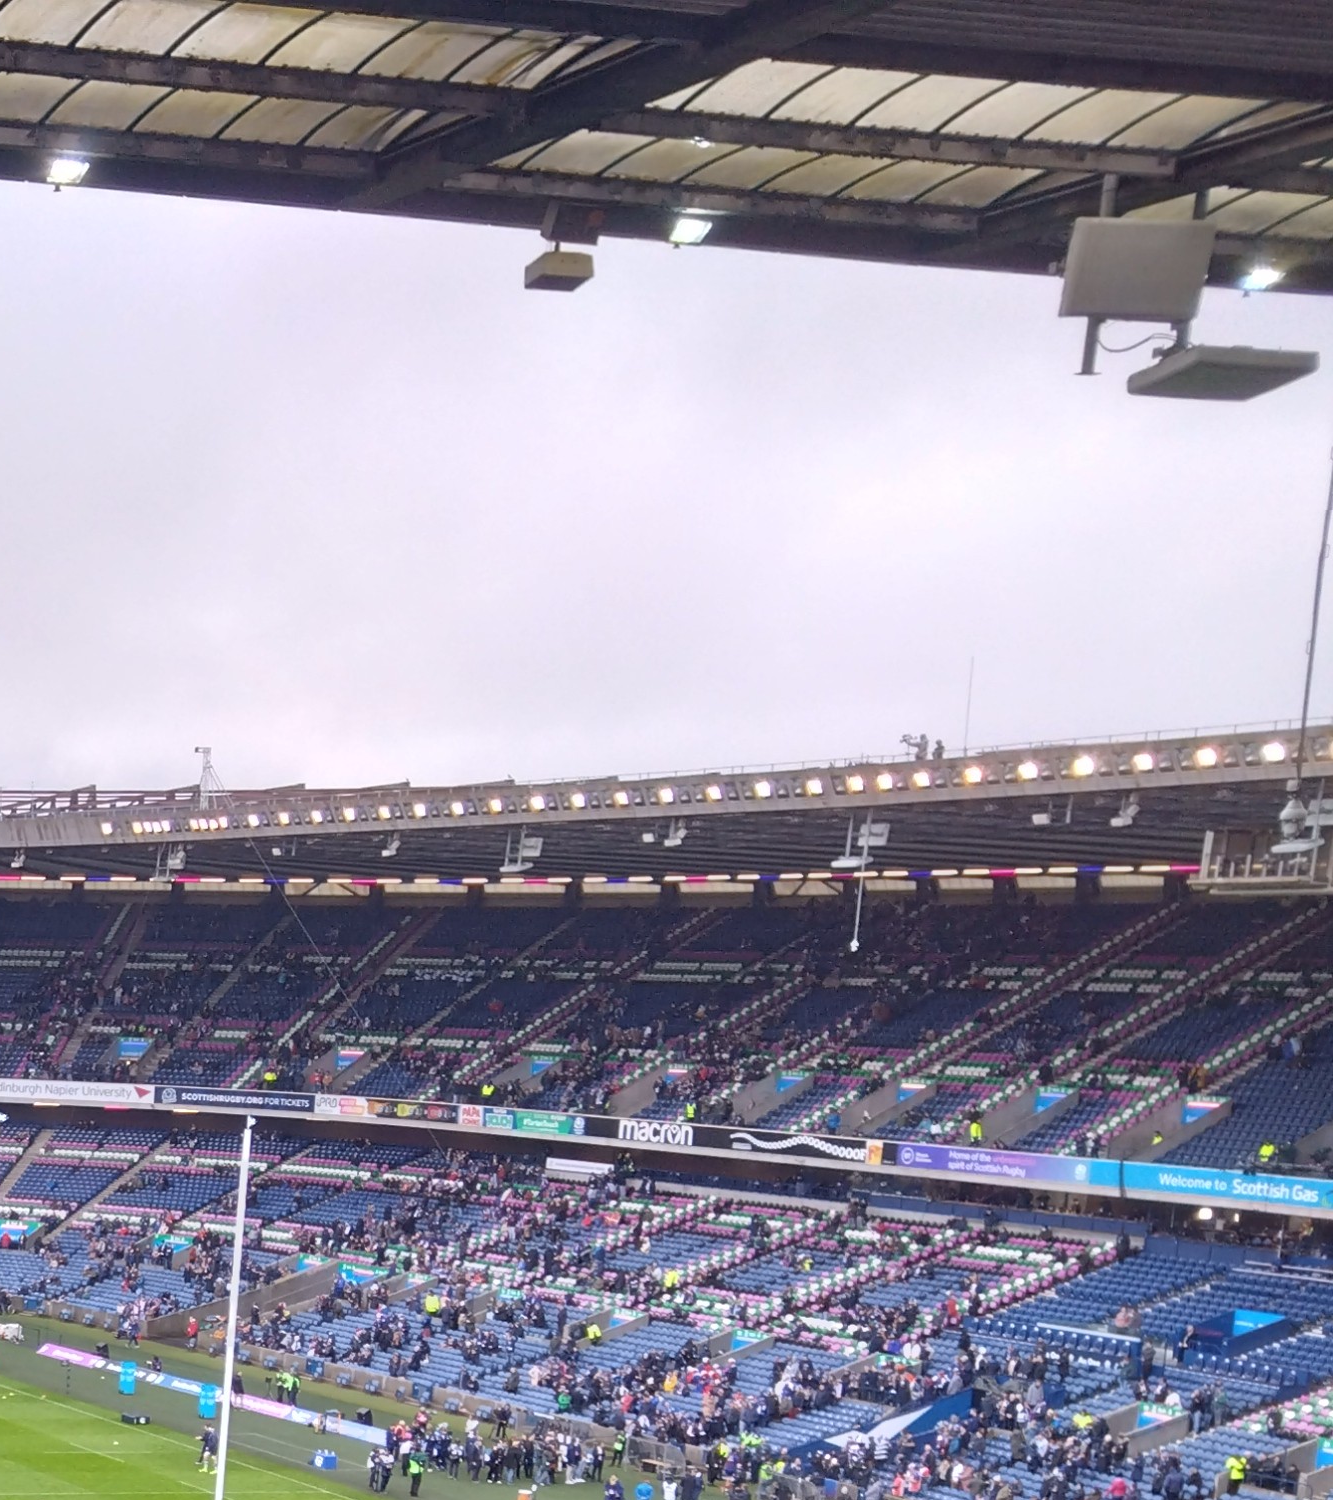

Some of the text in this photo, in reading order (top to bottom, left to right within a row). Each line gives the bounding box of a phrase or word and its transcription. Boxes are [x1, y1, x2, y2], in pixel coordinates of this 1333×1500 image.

[46, 1084, 79, 1097] Napier
[82, 1085, 132, 1099] University
[181, 1093, 310, 1108] SCOTTISHRUGBY.ORG FOR TICKETS
[618, 1120, 693, 1146] macron
[948, 1150, 970, 1159] Home
[979, 1153, 992, 1162] the
[948, 1160, 965, 1171] spirit
[974, 1162, 1003, 1173] Scottish
[1003, 1164, 1026, 1178] Rugby
[1159, 1173, 1319, 1203] Welcome to Scottish Gas
